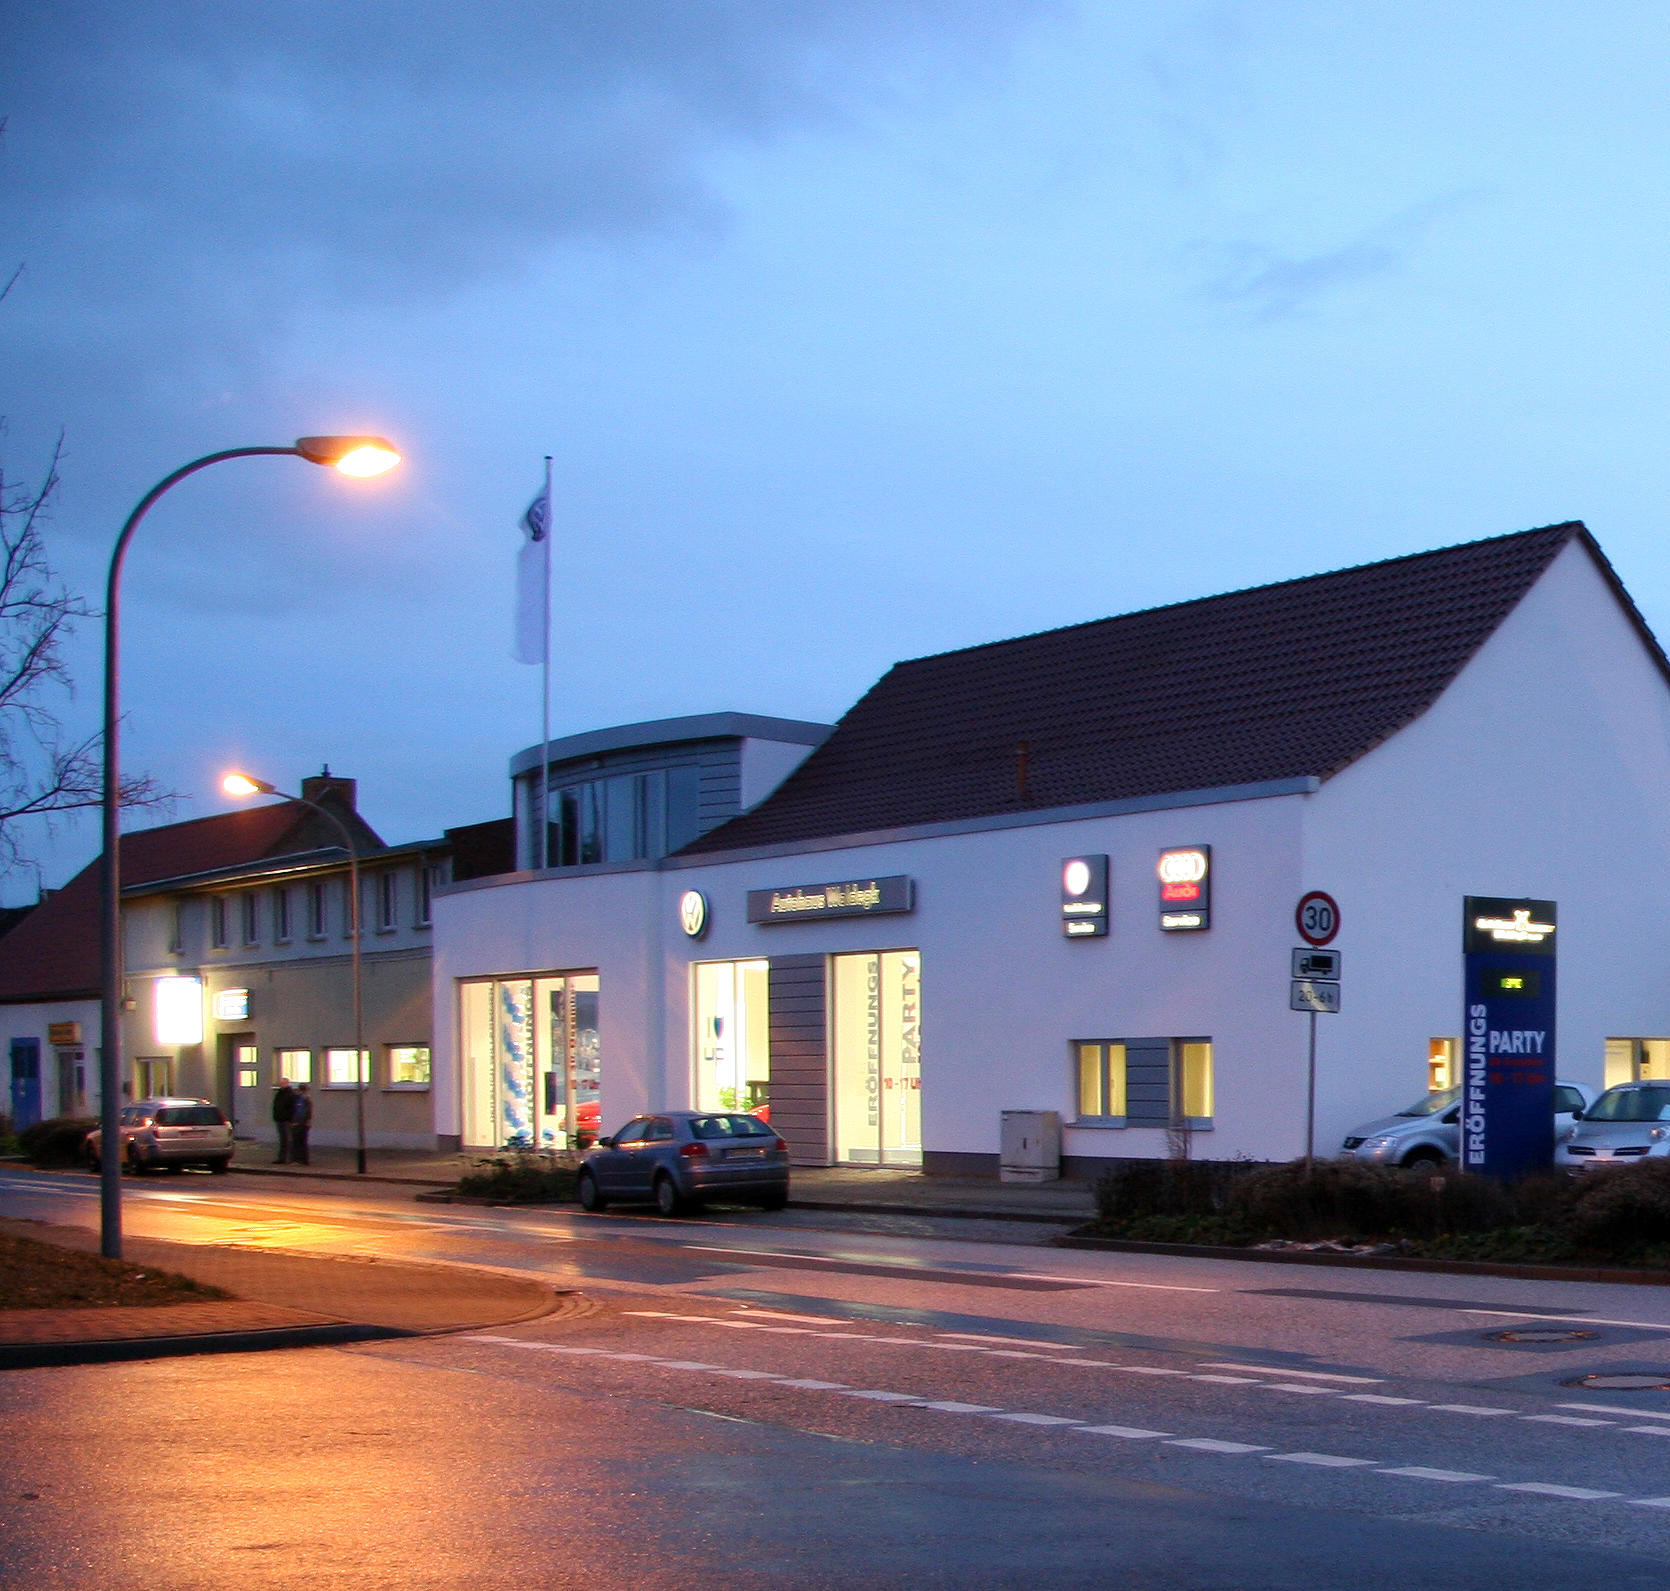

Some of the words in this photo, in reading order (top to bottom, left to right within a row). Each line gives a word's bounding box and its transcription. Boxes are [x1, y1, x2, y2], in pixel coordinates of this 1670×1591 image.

[1305, 906, 1331, 931] 30
[902, 960, 916, 1063] PARTY
[1490, 1031, 1546, 1053] PARTY
[1465, 1004, 1487, 1164] ERÖFFNUNGS
